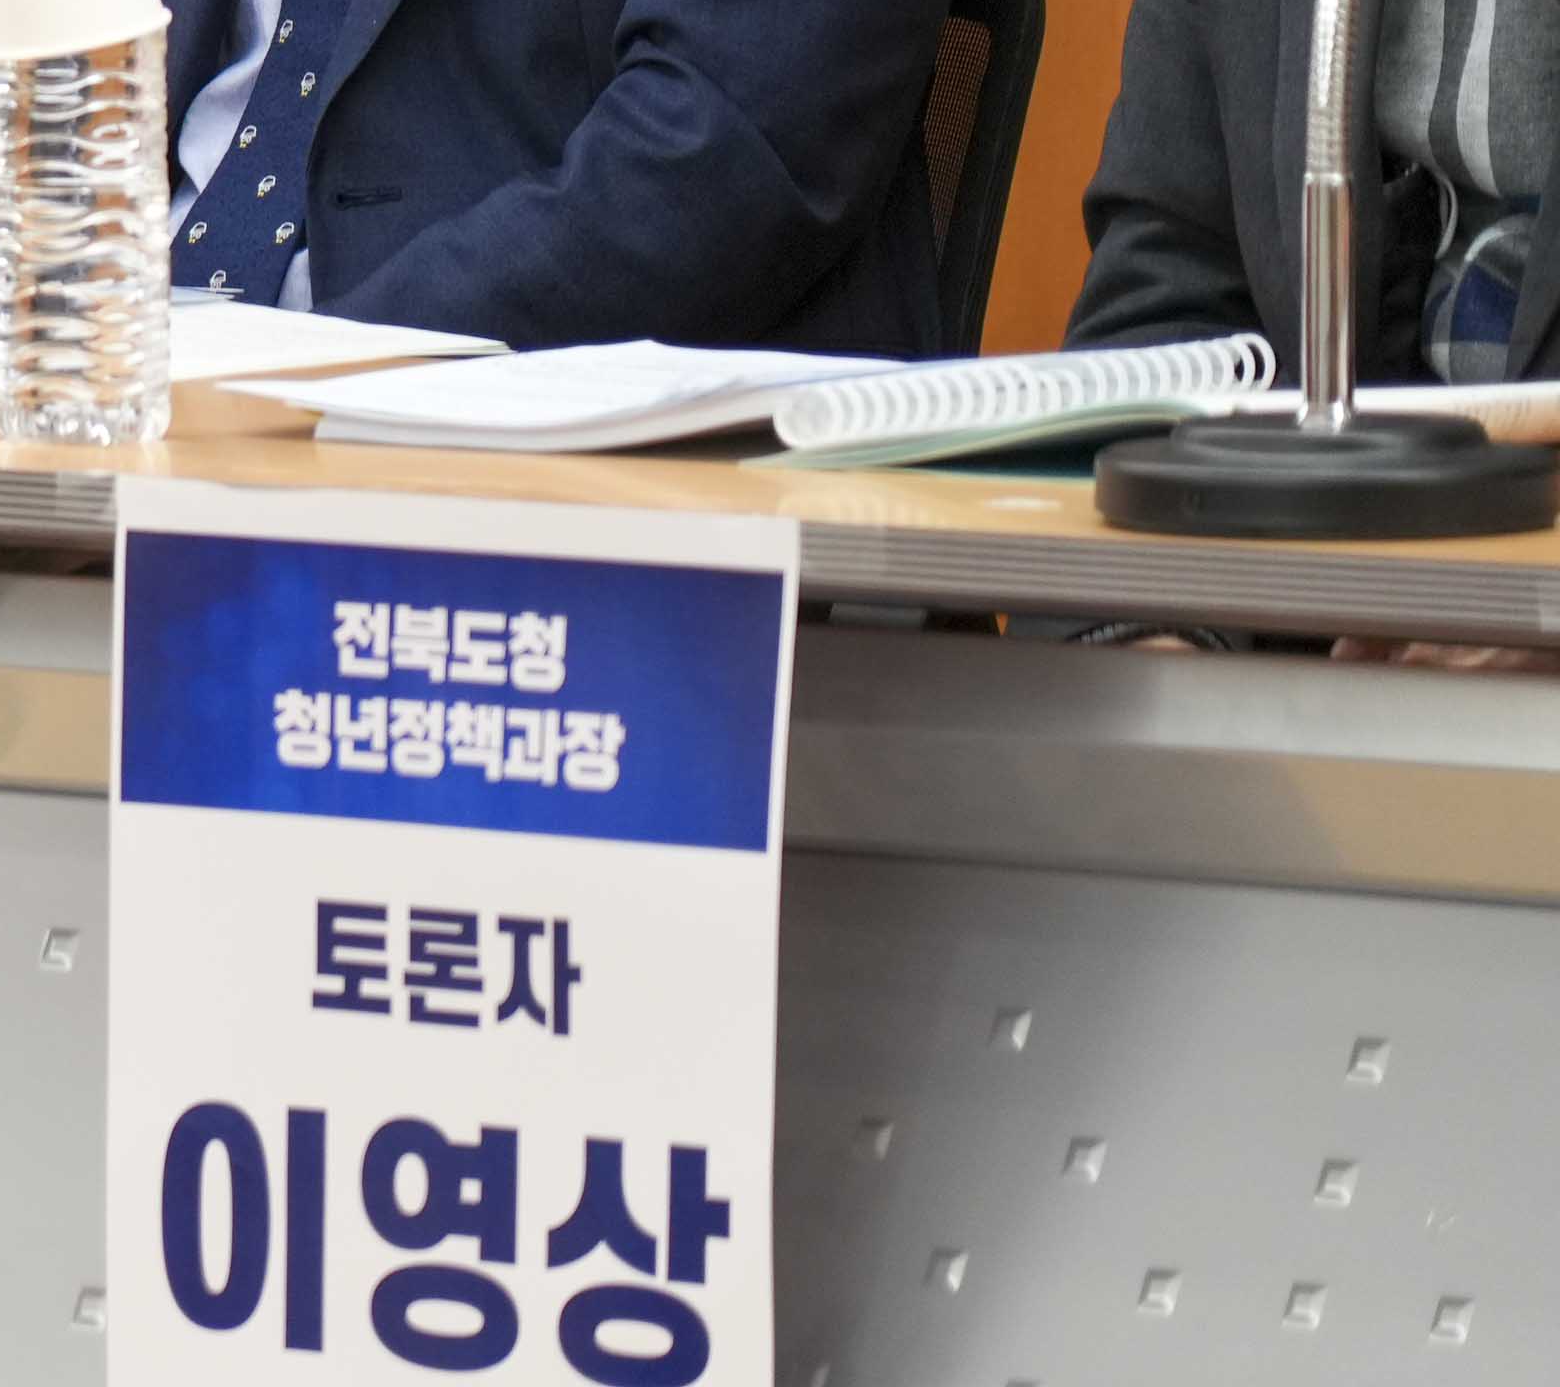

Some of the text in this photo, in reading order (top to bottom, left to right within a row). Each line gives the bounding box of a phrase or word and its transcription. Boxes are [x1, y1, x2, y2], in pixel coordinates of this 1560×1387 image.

[333, 601, 568, 693] 전북도청
[273, 688, 626, 791] 청년정책과장
[312, 900, 582, 1036] 토론자
[161, 1102, 731, 1387] 이영상
